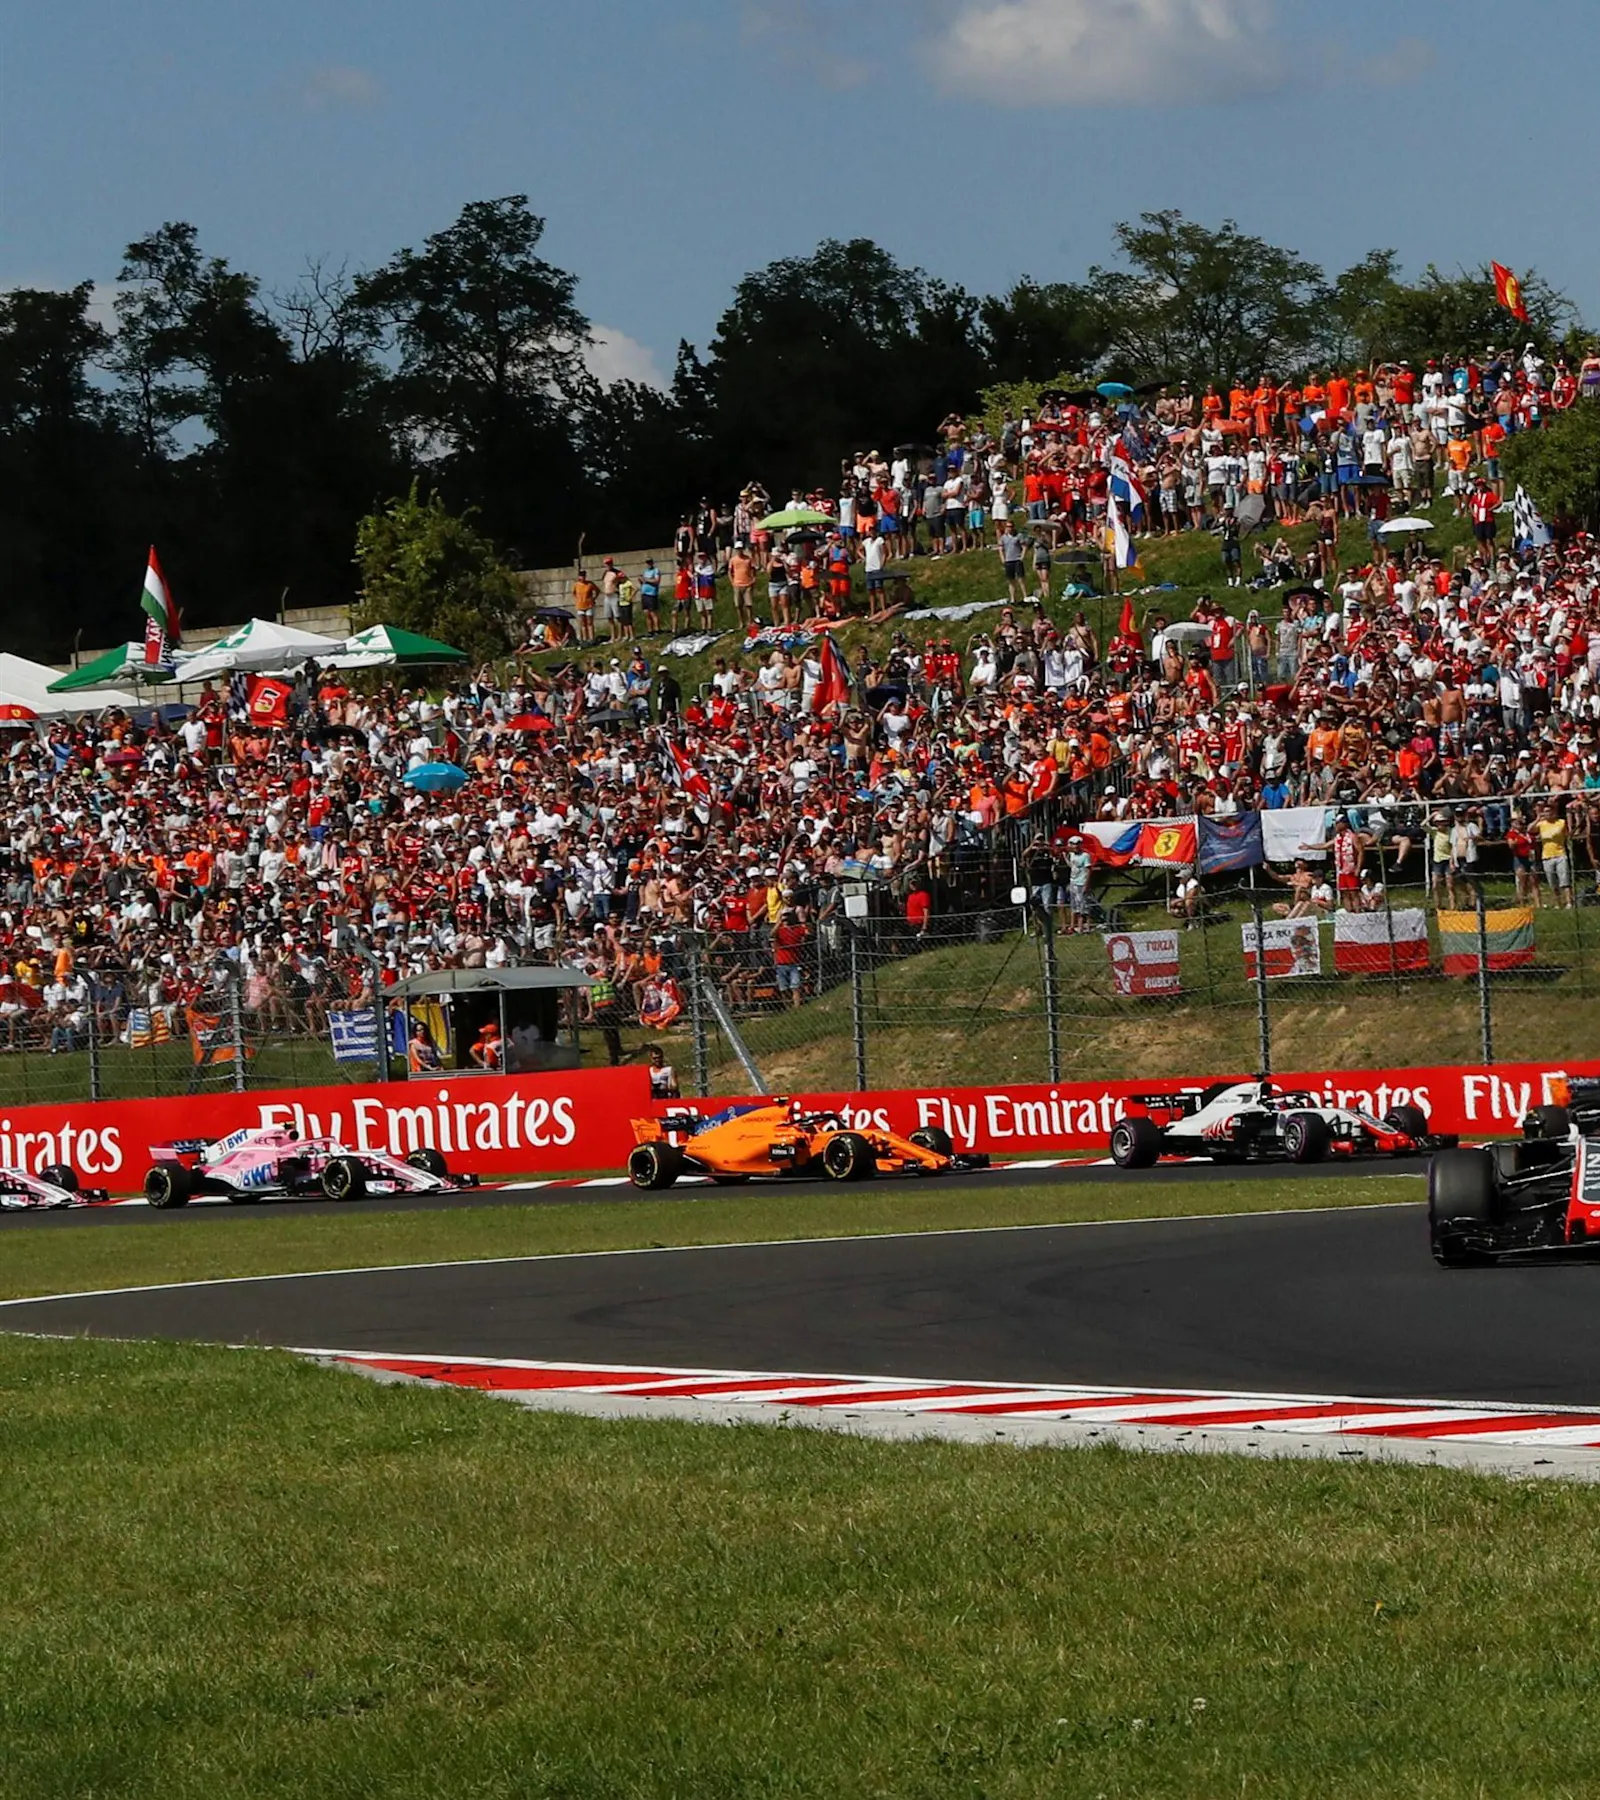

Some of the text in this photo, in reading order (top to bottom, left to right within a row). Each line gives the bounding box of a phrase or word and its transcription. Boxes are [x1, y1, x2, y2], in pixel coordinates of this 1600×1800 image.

[1245, 931, 1273, 941] FOZA
[352, 1089, 576, 1155] Emirates
[916, 1090, 1127, 1148] Fly Emirat
[1462, 1074, 1531, 1129] Fly
[227, 1129, 249, 1149] BWT
